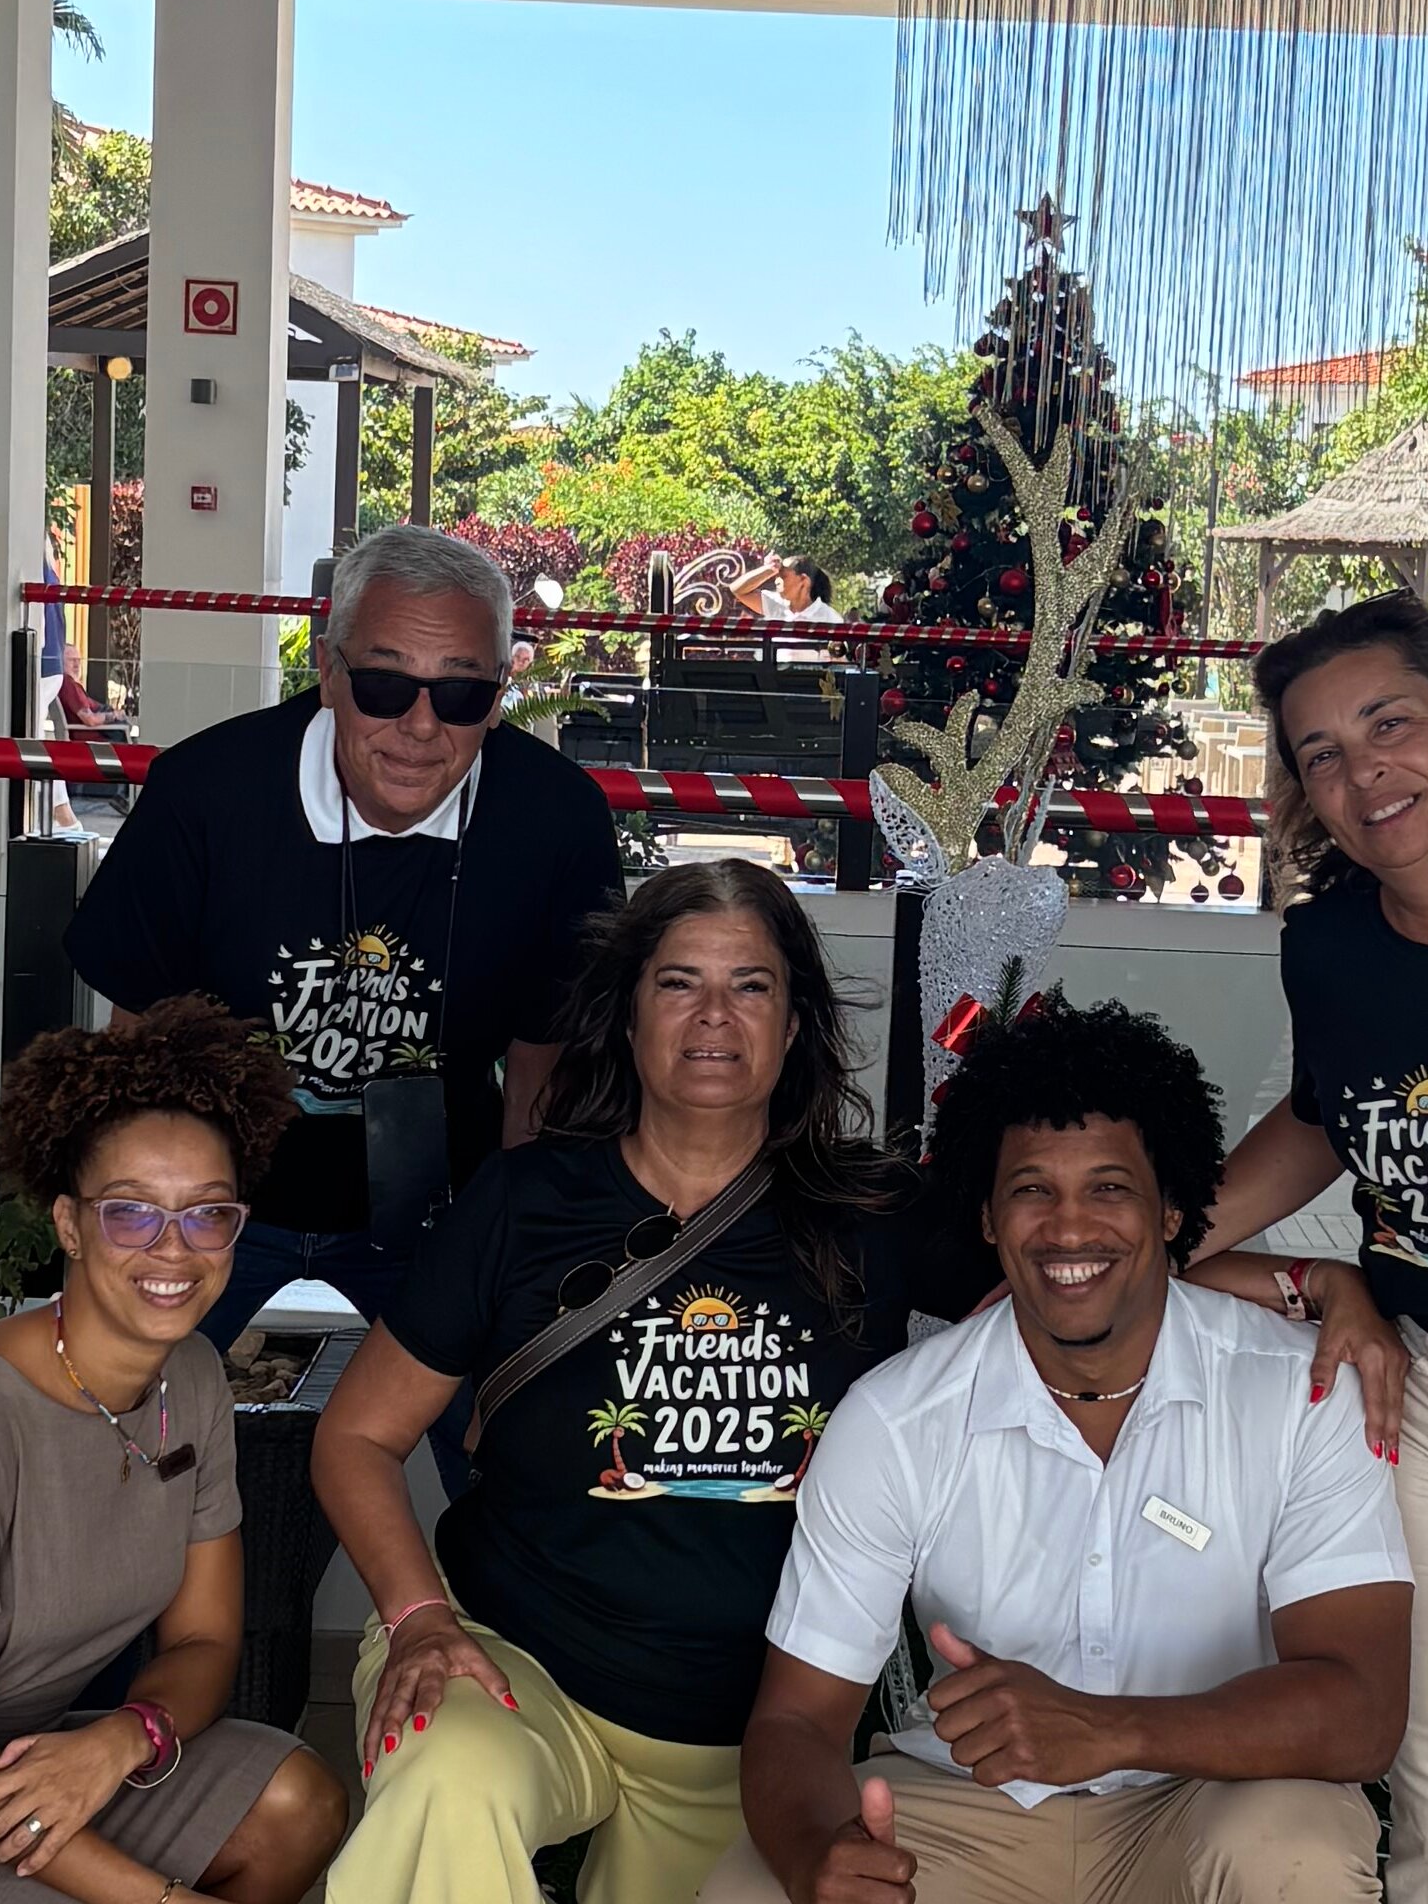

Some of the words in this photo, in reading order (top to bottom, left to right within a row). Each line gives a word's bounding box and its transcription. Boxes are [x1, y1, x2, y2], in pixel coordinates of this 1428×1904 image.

[284, 1028, 388, 1079] 2025
[632, 1317, 782, 1362] Friends
[615, 1359, 810, 1400] VACATION
[653, 1405, 775, 1454] 2025
[643, 1458, 683, 1477] making
[686, 1462, 738, 1475] memories
[741, 1460, 784, 1477] together
[1159, 1509, 1194, 1535] BRUNO
